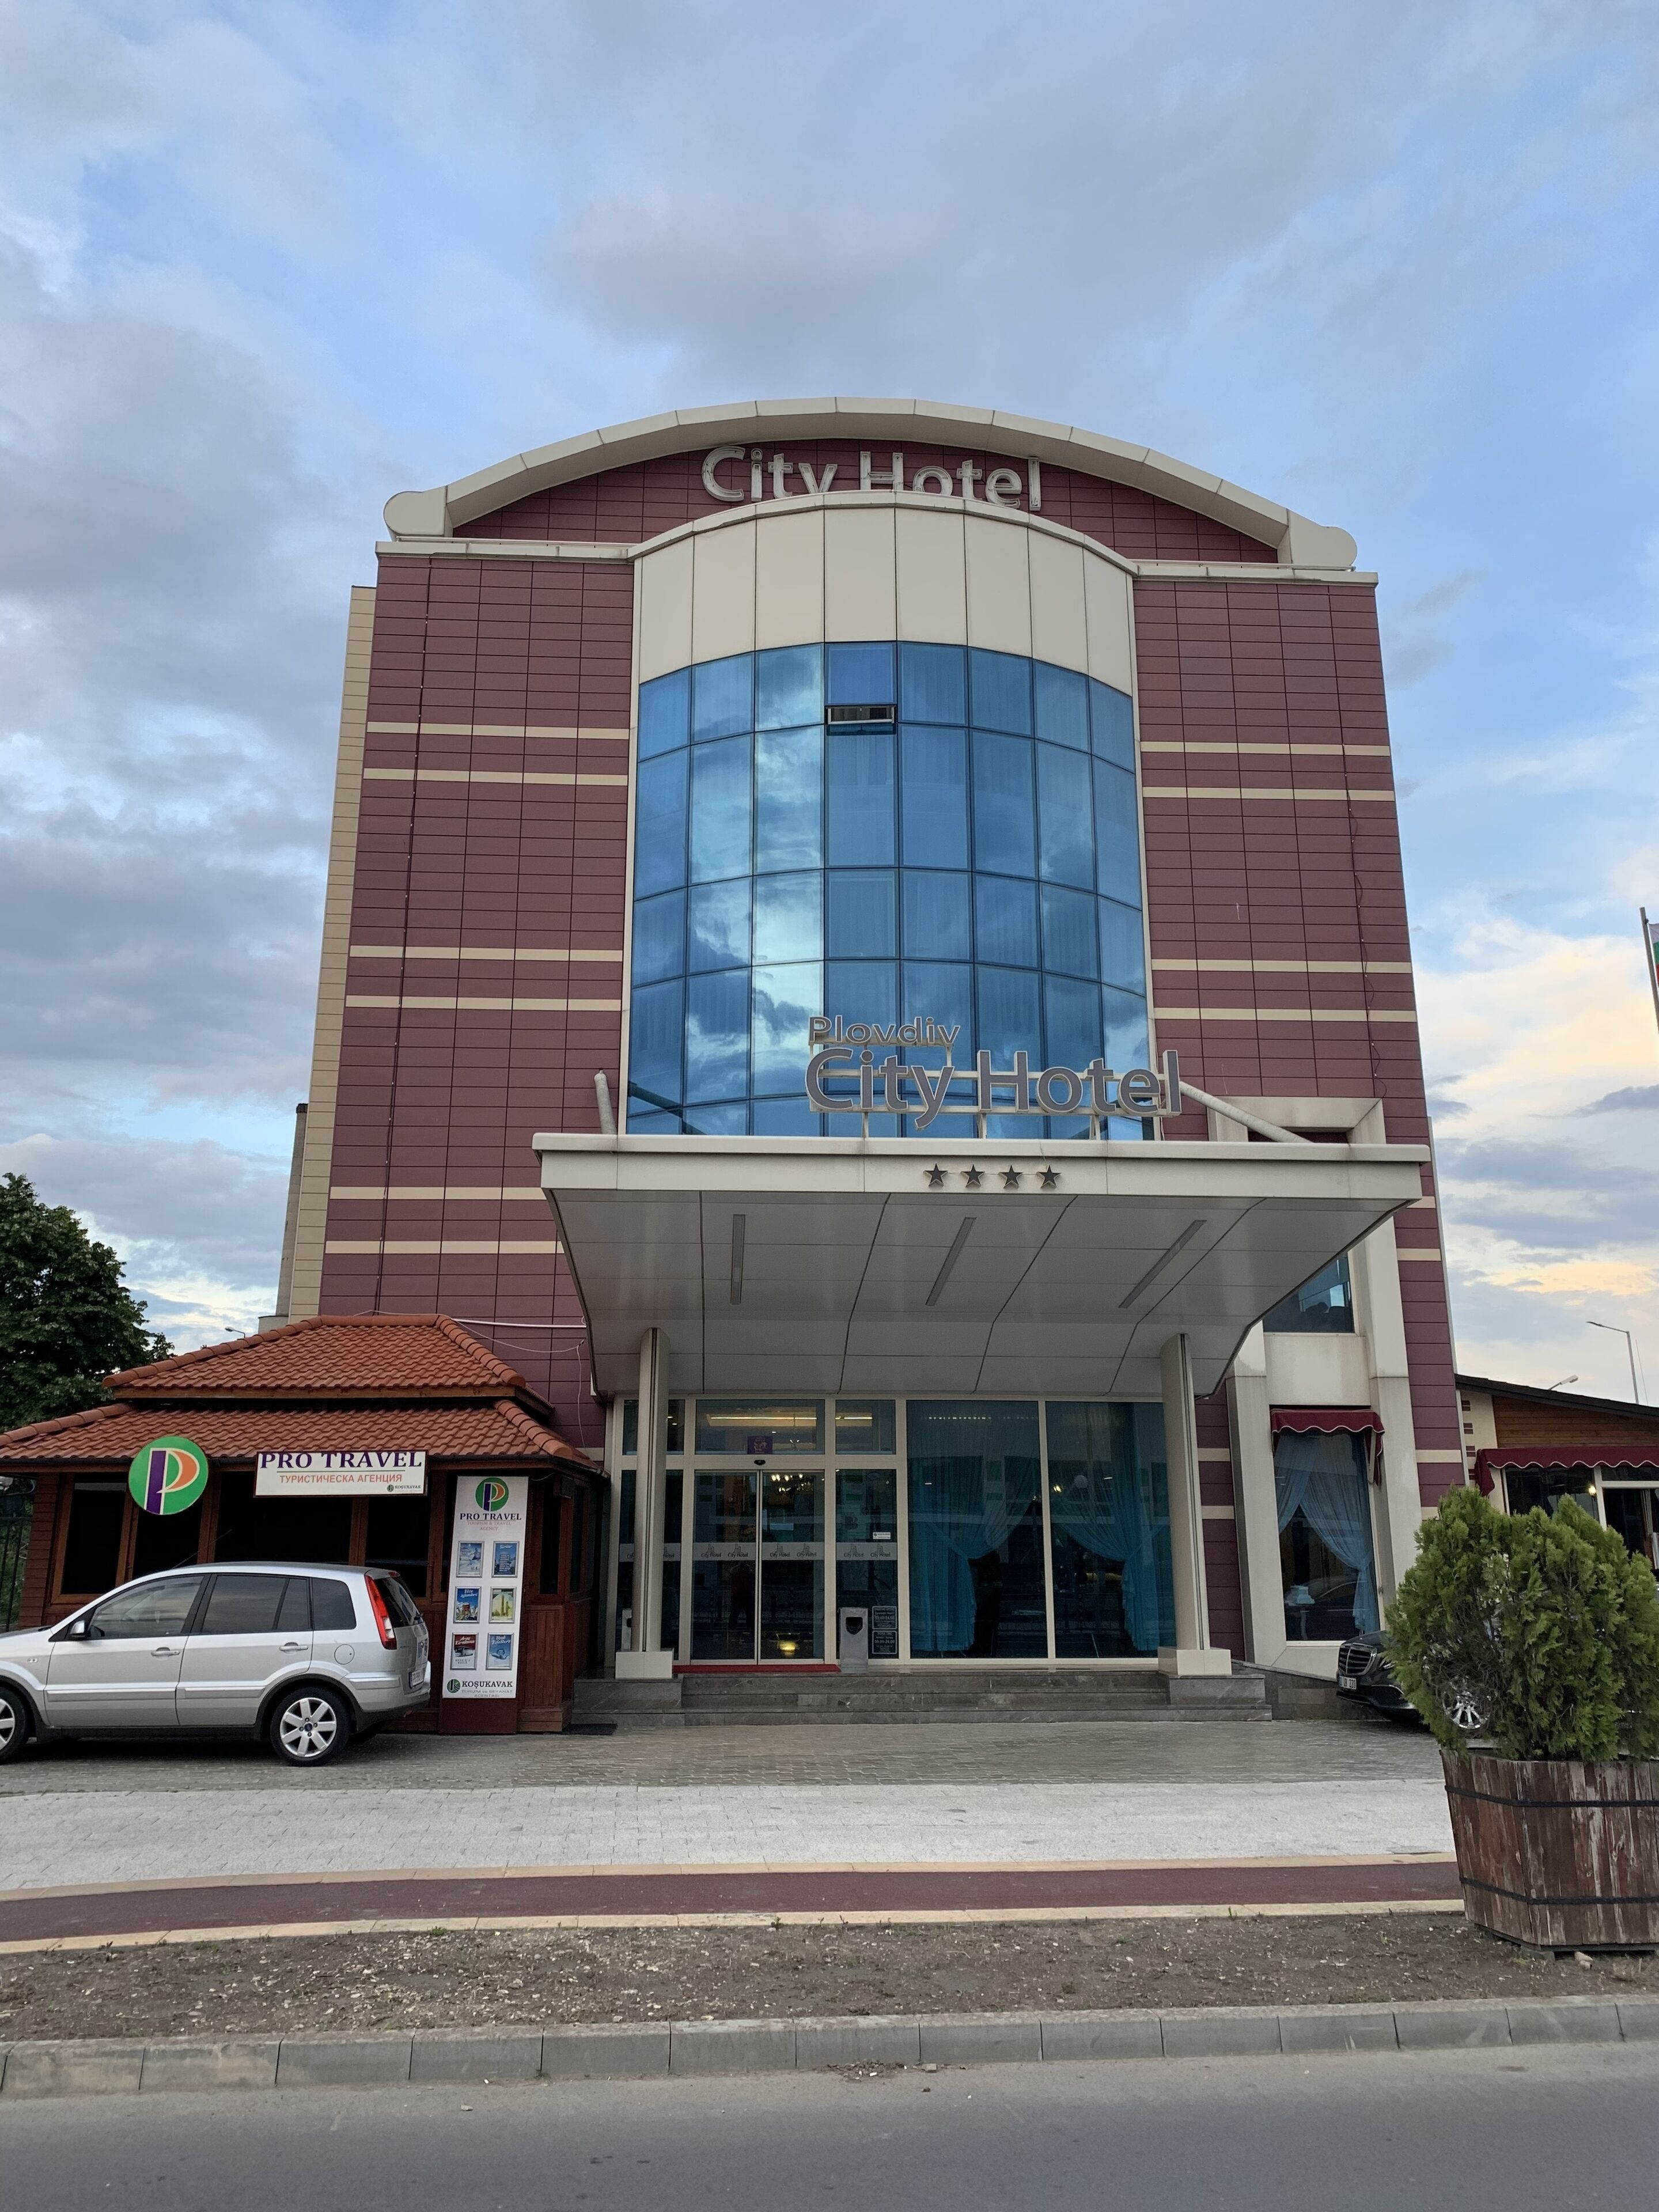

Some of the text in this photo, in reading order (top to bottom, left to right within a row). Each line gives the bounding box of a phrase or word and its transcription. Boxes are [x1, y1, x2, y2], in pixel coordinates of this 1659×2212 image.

[702, 446, 1041, 511] City Hotel
[808, 1015, 961, 1044] Plovdiv
[805, 1047, 1182, 1130] City Hotel
[260, 1451, 422, 1468] PRO TRAVEL
[279, 1474, 402, 1484] ТУРИСТИЧЕСКА АГЕНЦИЯ
[483, 1513, 522, 1521] TRAVEL
[462, 1681, 513, 1689] KOŞUKAVAK
